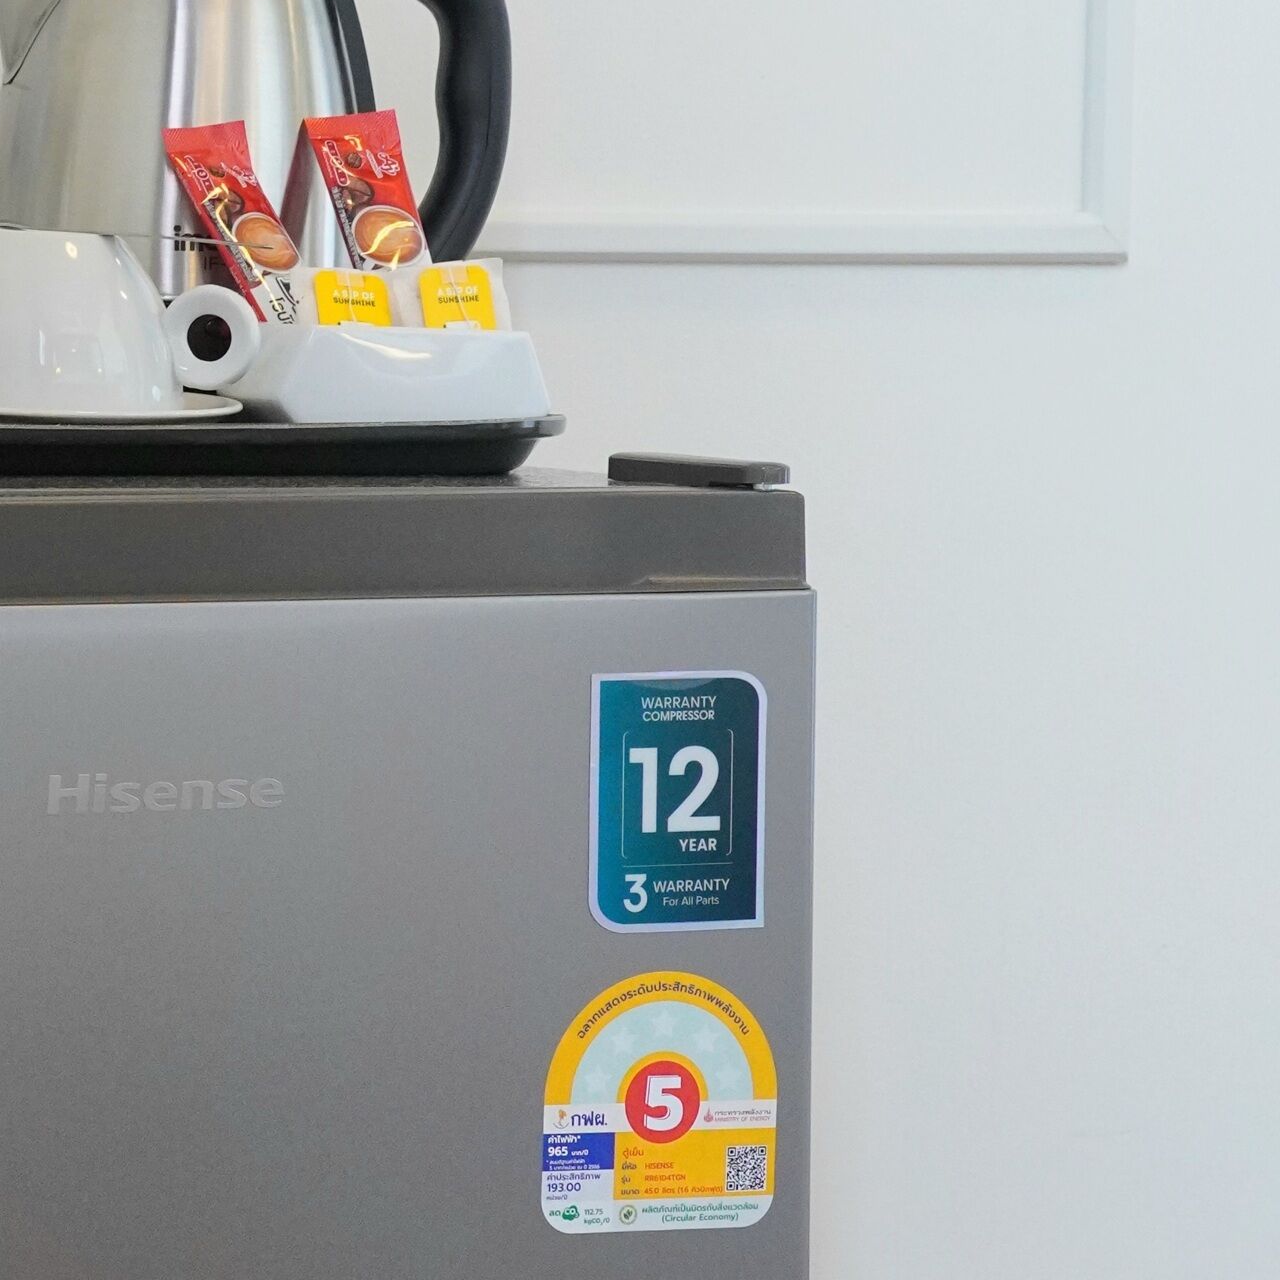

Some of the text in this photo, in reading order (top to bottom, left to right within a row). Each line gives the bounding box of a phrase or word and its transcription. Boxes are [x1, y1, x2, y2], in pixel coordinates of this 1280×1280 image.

[362, 291, 376, 300] OF
[465, 286, 479, 294] OF
[333, 296, 376, 307] SUNSHINE
[437, 295, 480, 304] SUNSHINE
[641, 696, 717, 709] WARRANTY
[642, 710, 715, 722] COMPRESSOR
[46, 773, 286, 816] Hisense
[629, 745, 721, 834] 12
[679, 838, 717, 852] YEAR
[623, 873, 730, 913] 3 WARRANTY
[662, 895, 720, 907] For All Parts
[643, 1074, 684, 1132] 5
[571, 1110, 608, 1127] กฟผ.
[547, 1146, 569, 1157] 965
[622, 1146, 645, 1159] ตู้เย็น
[644, 1161, 675, 1170] HISENSE
[546, 1172, 601, 1182] ค่าประสิทธิภาพ
[549, 1209, 561, 1217] ลด
[661, 1211, 740, 1224] (Circular Economy)
